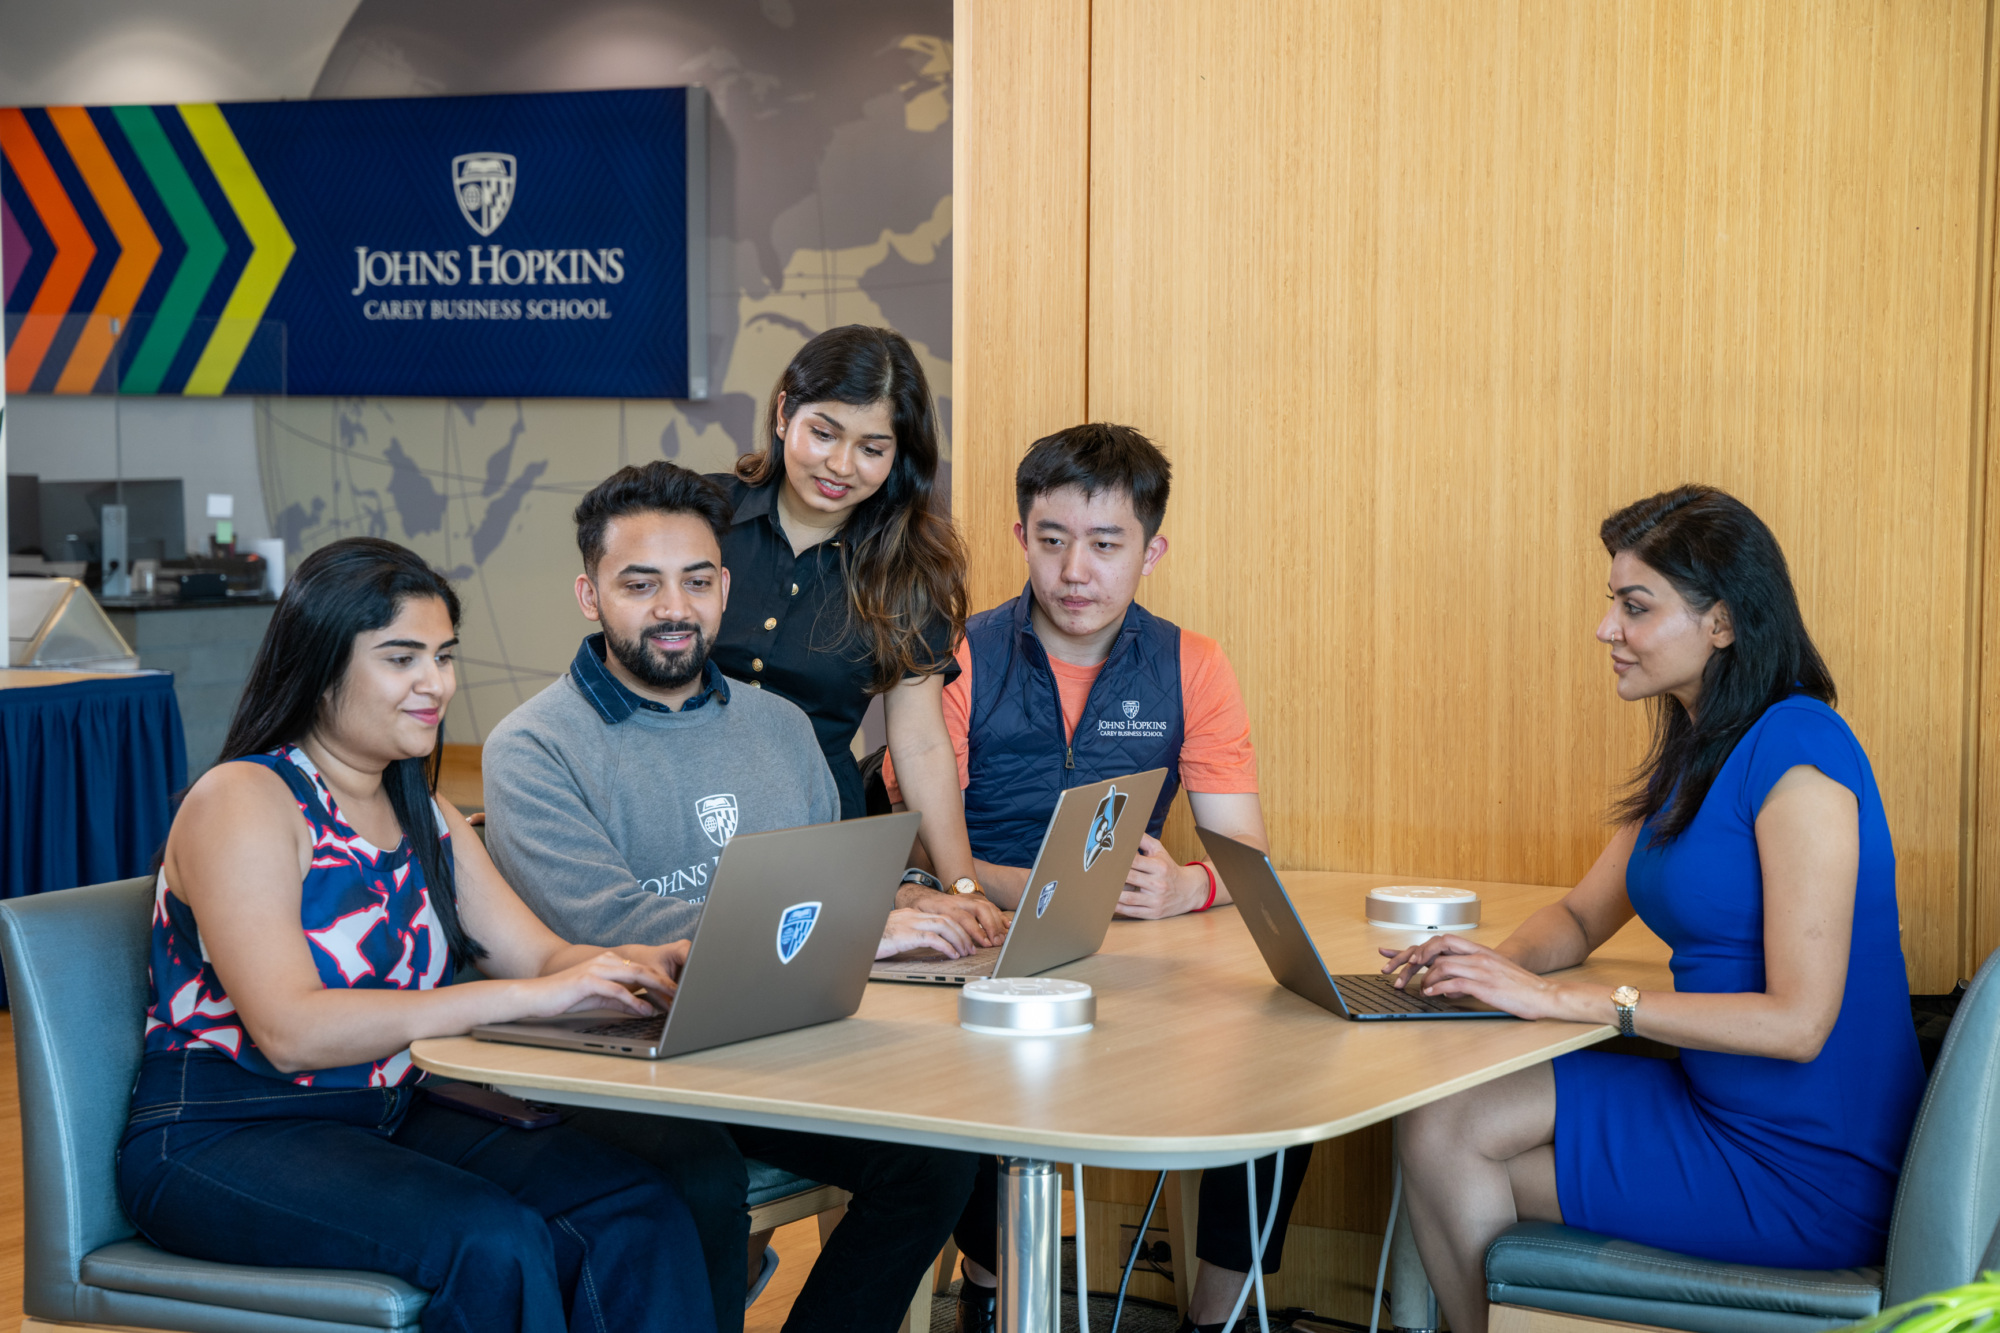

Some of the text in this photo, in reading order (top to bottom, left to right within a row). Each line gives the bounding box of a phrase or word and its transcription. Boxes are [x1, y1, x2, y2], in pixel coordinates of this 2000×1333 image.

[352, 245, 625, 296] JOHNS HOPKINS
[363, 299, 612, 320] CAREY BUSINESS SCHOOL
[1097, 720, 1167, 731] JOHNS HOPKINS
[637, 863, 707, 897] OHNS
